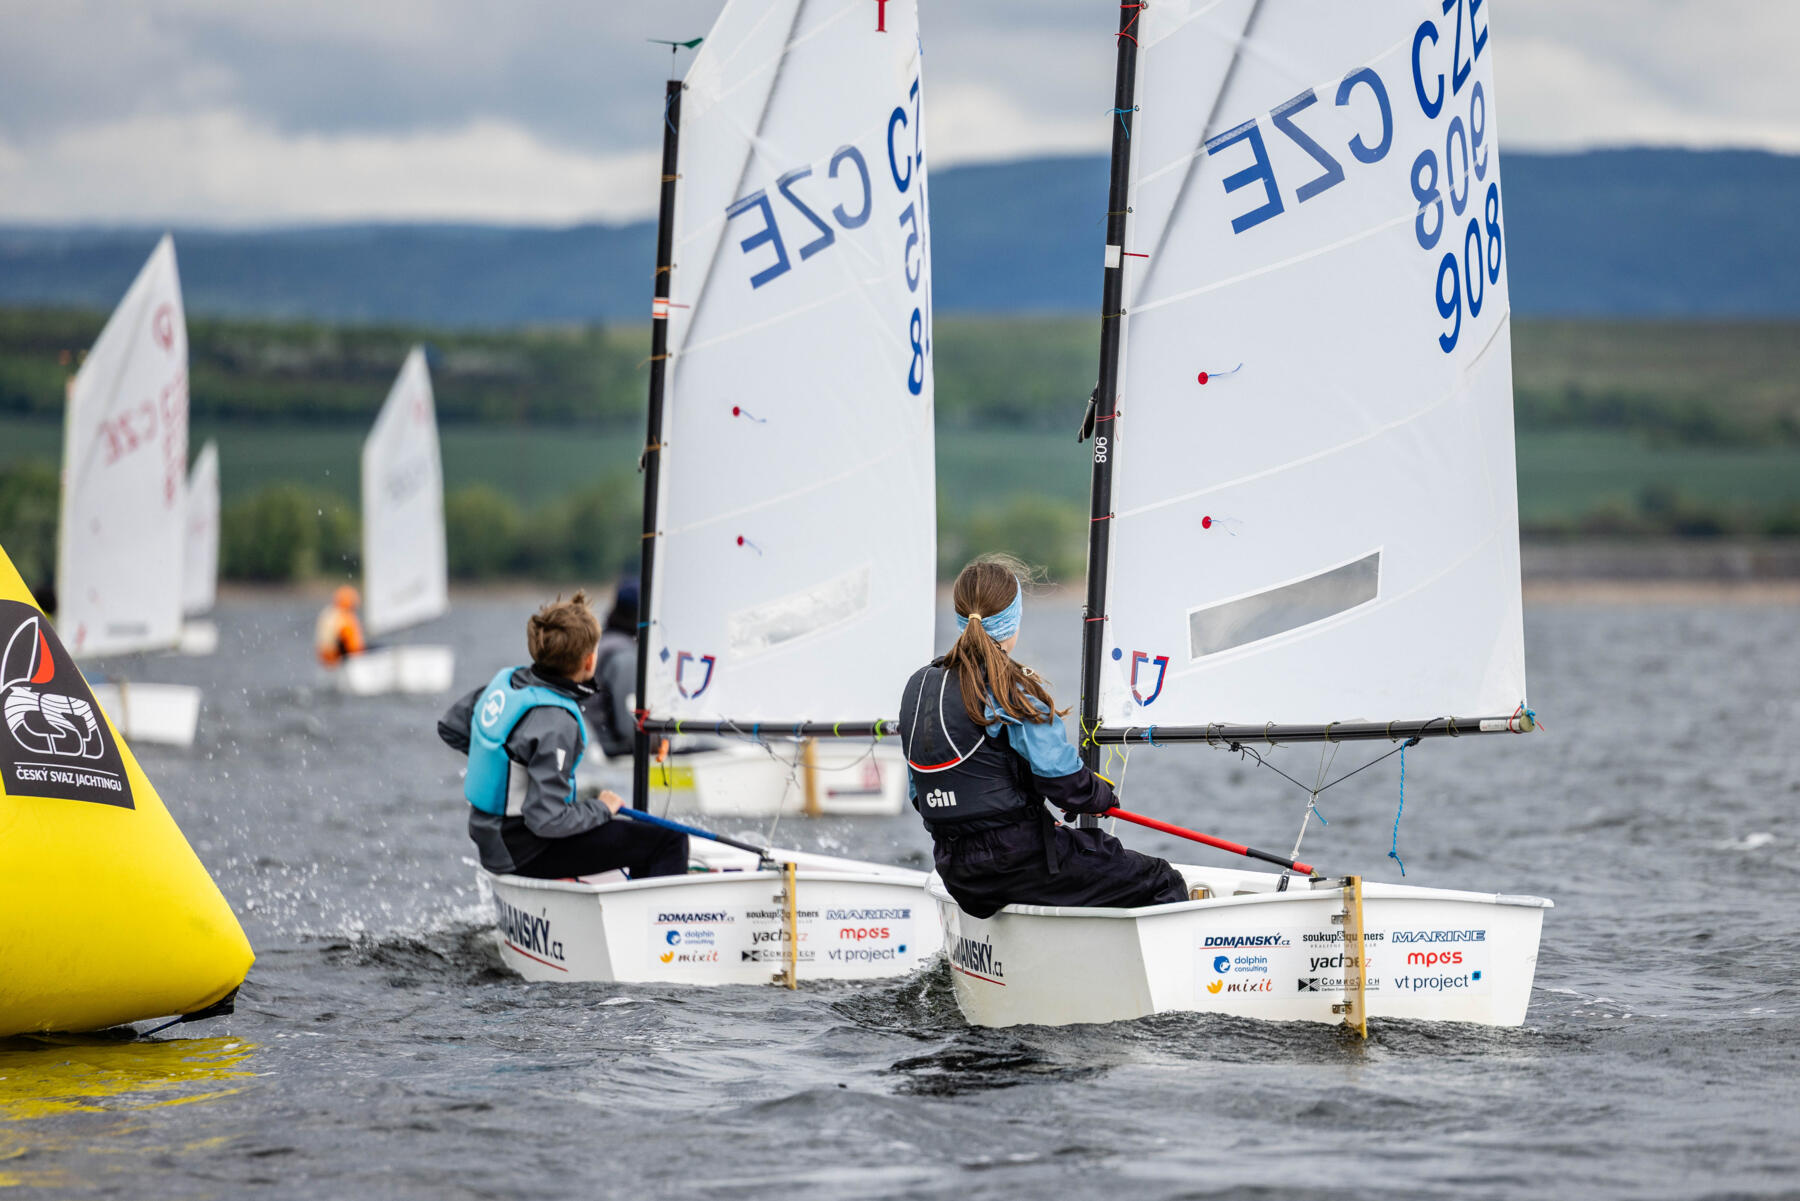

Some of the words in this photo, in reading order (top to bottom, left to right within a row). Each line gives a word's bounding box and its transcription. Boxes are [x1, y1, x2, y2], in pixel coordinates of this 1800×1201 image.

[1412, 0, 1489, 119] CZE
[1436, 182, 1501, 353] 908
[1095, 437, 1108, 463] 908
[16, 766, 48, 782] ČESKÝ
[50, 771, 75, 785] SVAZ
[76, 775, 123, 792] JACHTINGU
[926, 788, 957, 808] Gill
[826, 909, 911, 920] MARINE
[685, 930, 715, 939] dolphin
[1204, 932, 1291, 949] DOMANSKÝ.cz
[1391, 930, 1486, 943] MARINE
[678, 950, 720, 962] mixit
[828, 949, 842, 960] vt
[845, 947, 896, 963] project
[1234, 956, 1268, 966] dolphin
[1227, 979, 1273, 992] mixit
[1394, 976, 1409, 988] vt
[1413, 974, 1469, 992] project
